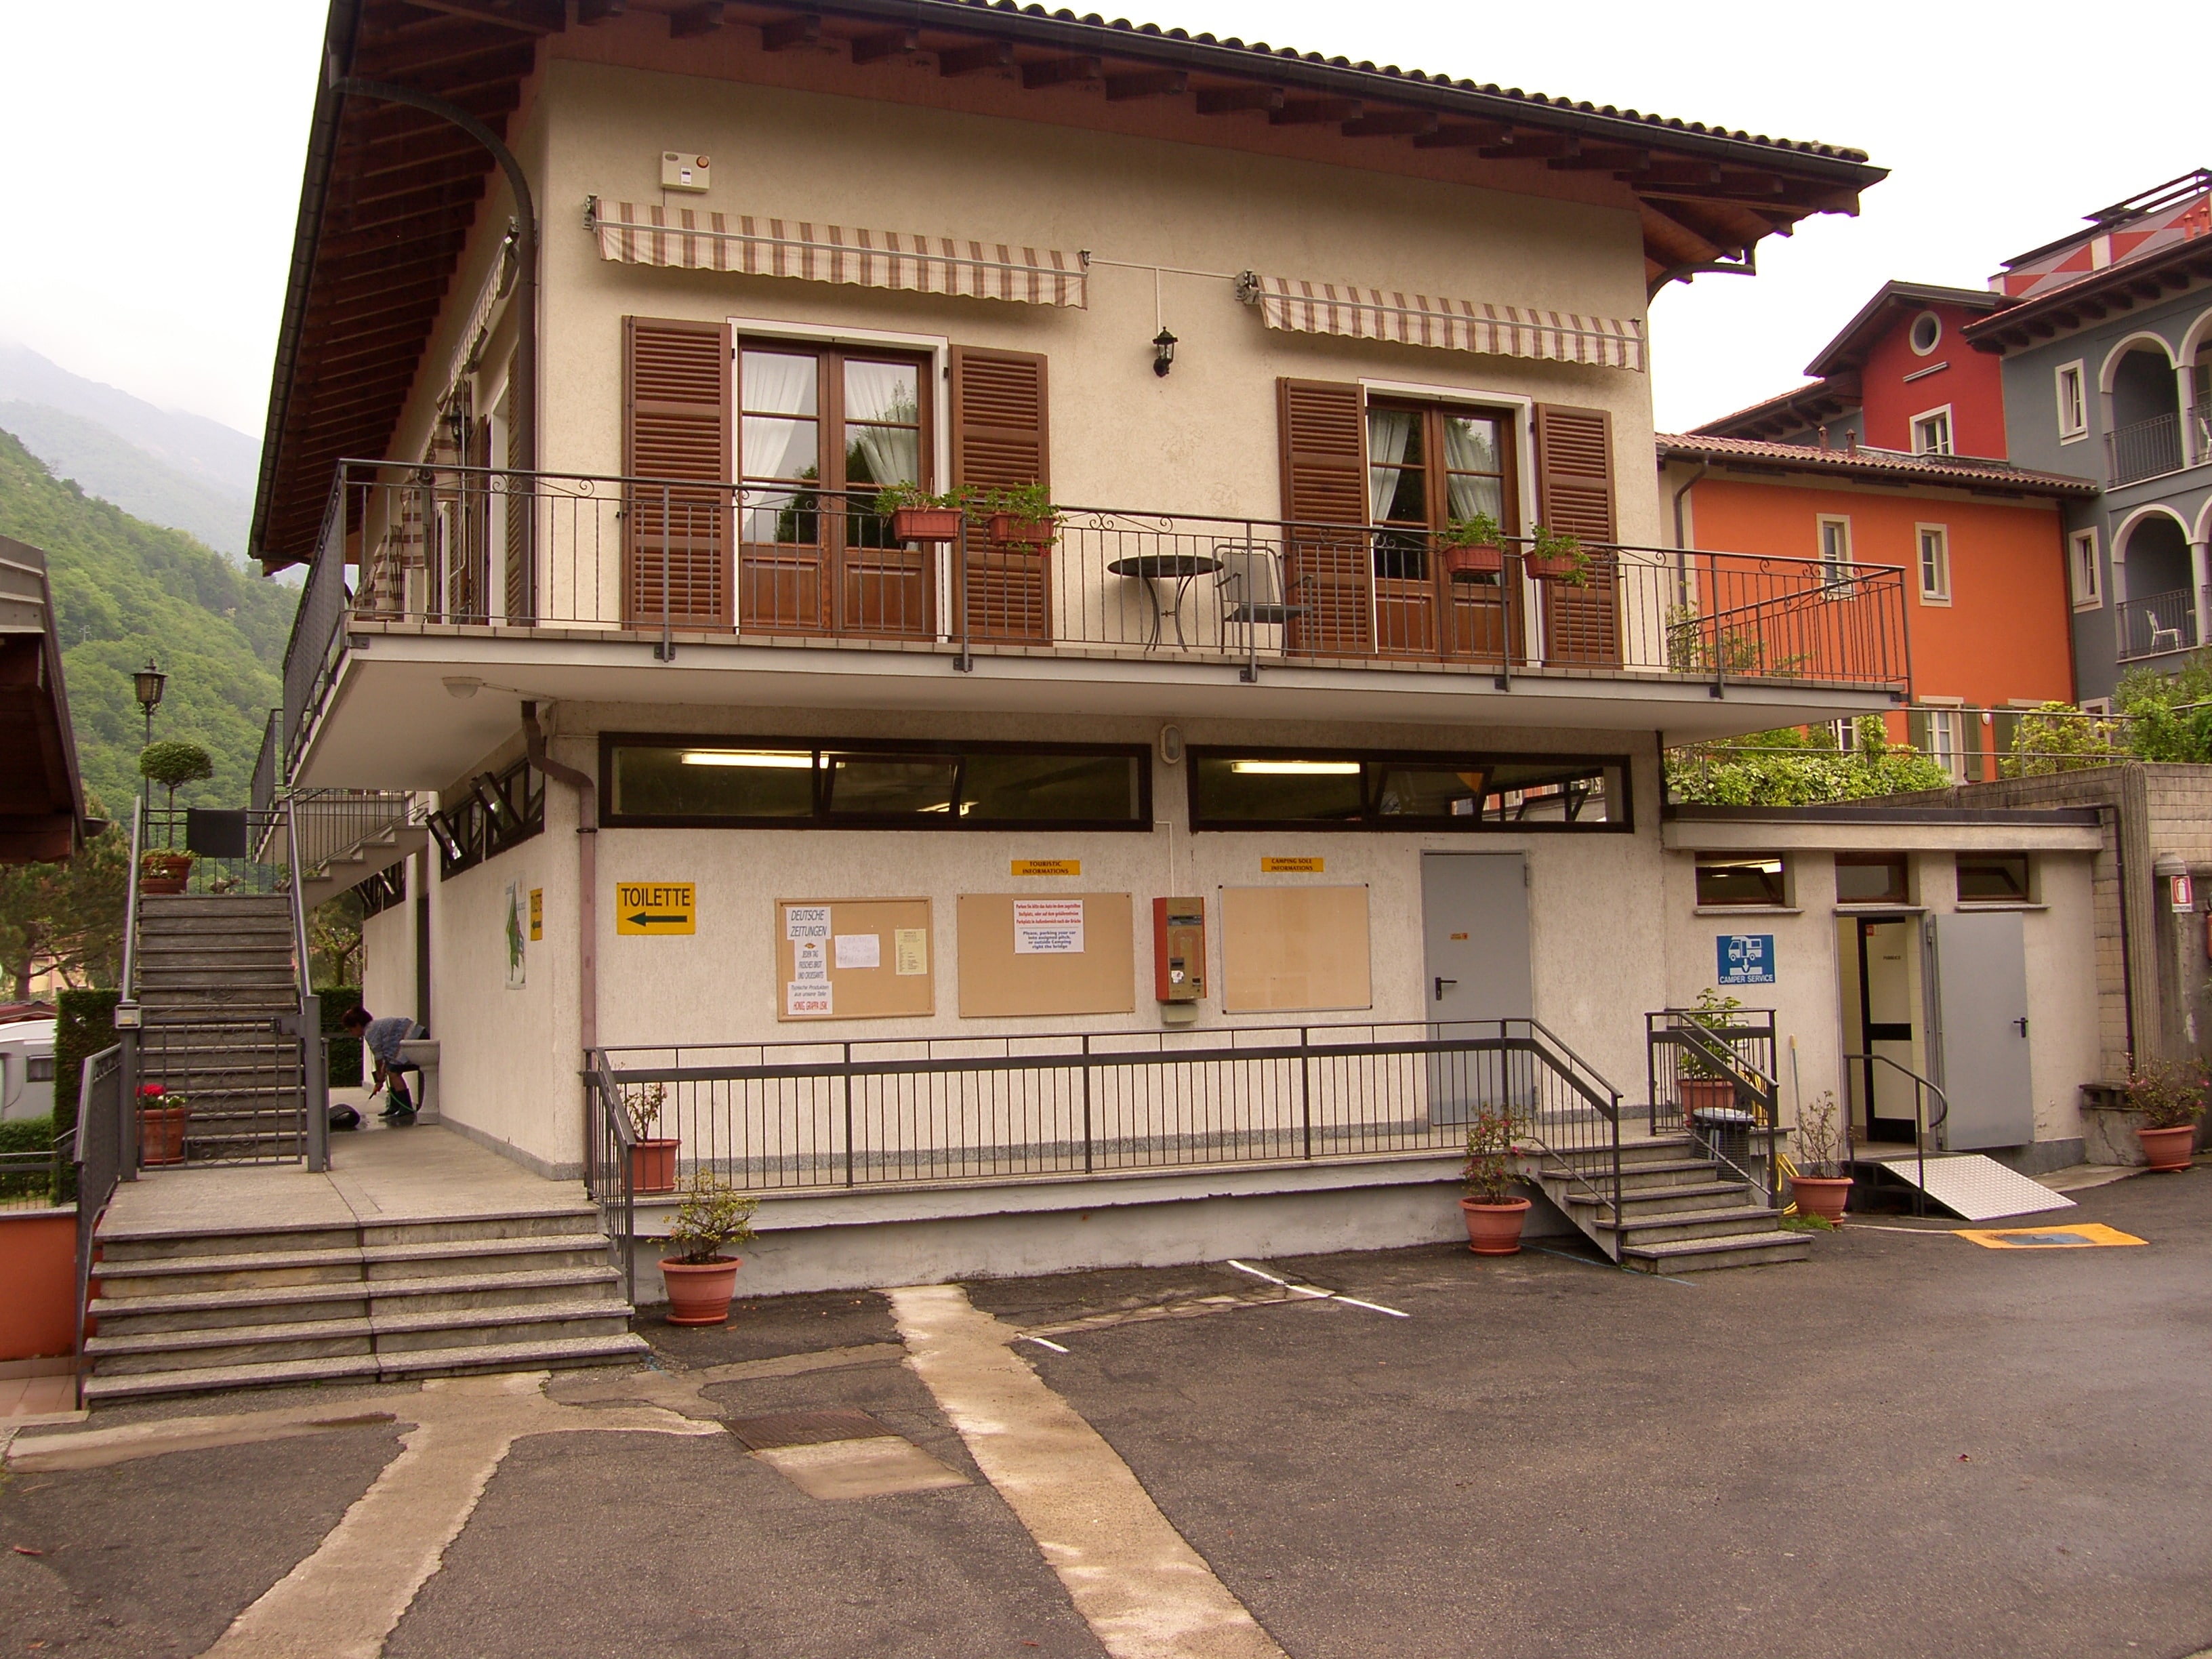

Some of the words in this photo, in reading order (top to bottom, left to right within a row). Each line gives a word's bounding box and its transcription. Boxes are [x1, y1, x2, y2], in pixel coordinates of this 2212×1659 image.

[621, 887, 691, 907] TOILETTE
[791, 909, 825, 921] DEUTSCHE
[790, 926, 827, 937] ZEITUNGEN
[1747, 974, 1774, 982] SERVICE
